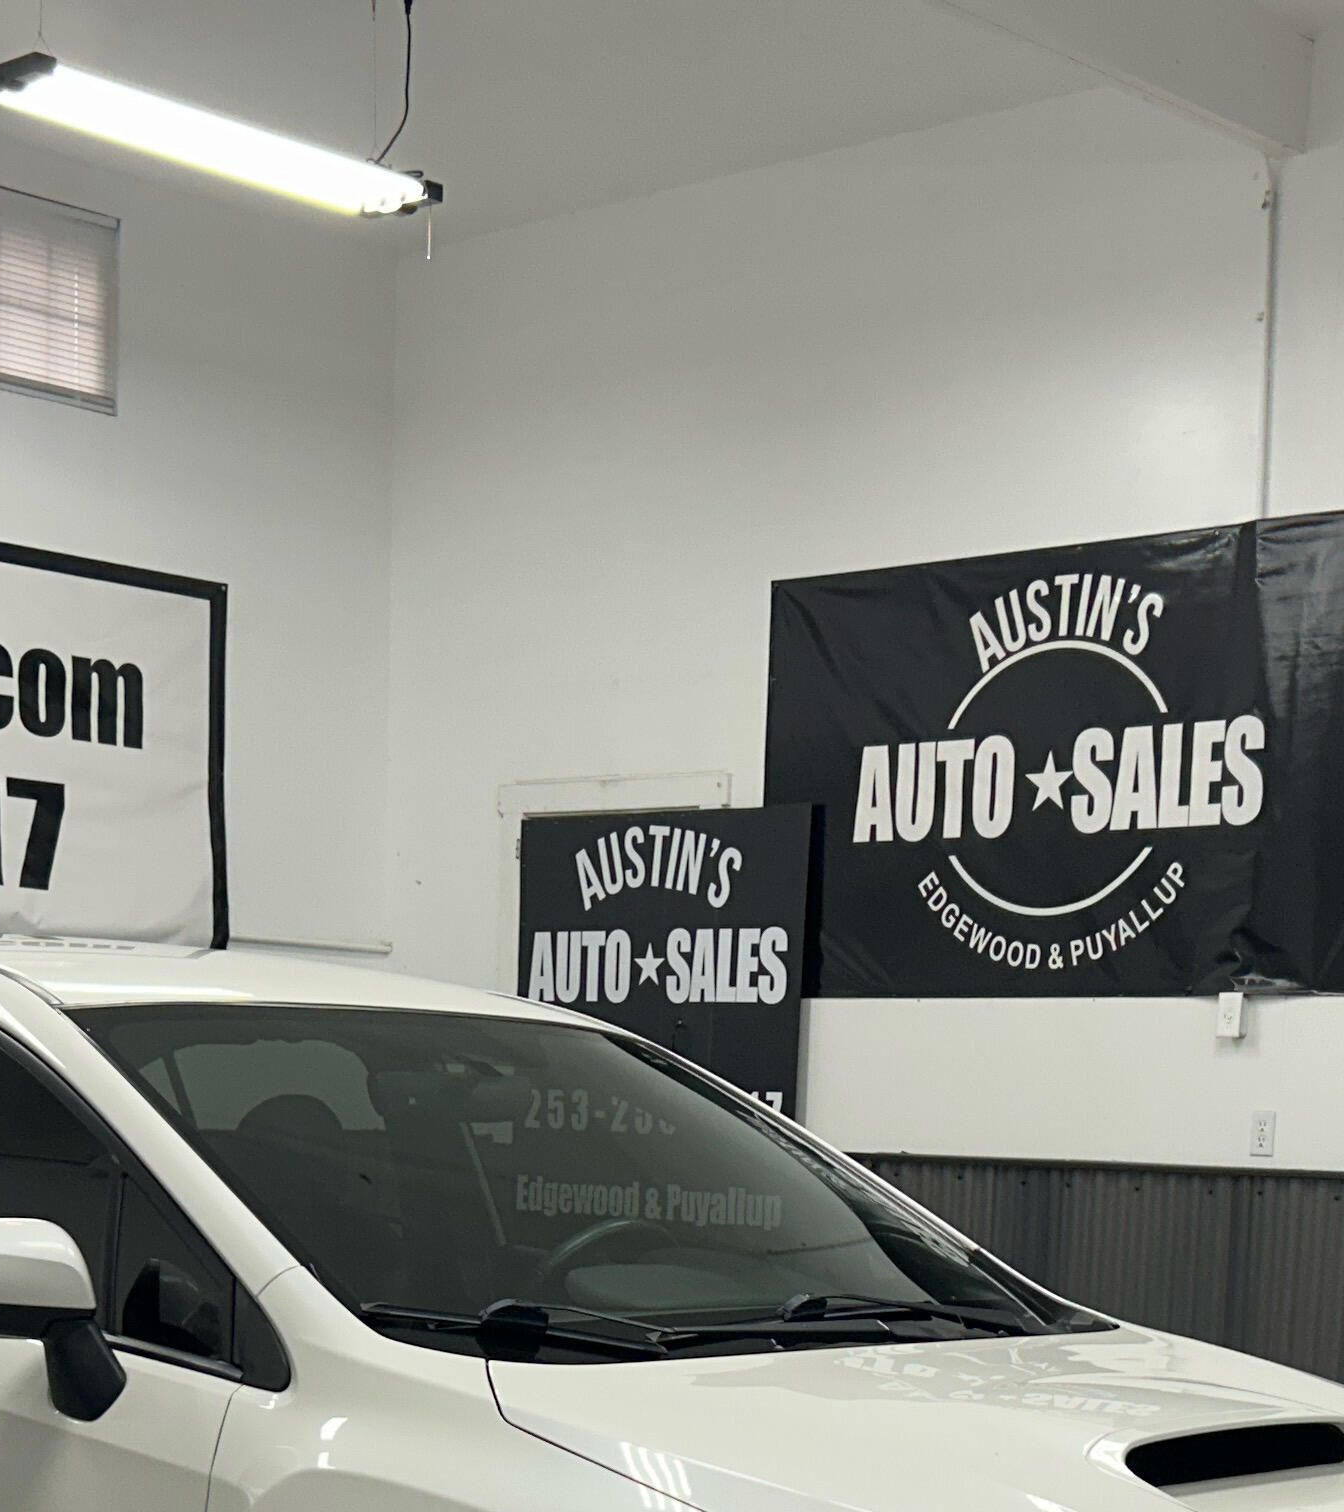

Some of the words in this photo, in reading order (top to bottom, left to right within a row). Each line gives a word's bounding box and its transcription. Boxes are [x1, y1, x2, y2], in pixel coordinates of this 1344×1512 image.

[969, 573, 1164, 674] AUSTIN'S
[852, 734, 1016, 844] AUTO
[1070, 714, 1266, 835] SALES
[575, 824, 743, 912] AUSTIN'S
[917, 871, 1042, 970] EDGEWOOD
[1047, 943, 1064, 970] &
[1069, 861, 1186, 967] PUYALLUP
[527, 928, 632, 1005] AUTO
[665, 926, 789, 1005] SALES
[516, 1174, 641, 1217] Edgewood
[644, 1187, 662, 1220] &
[666, 1183, 783, 1231] Puyallup
